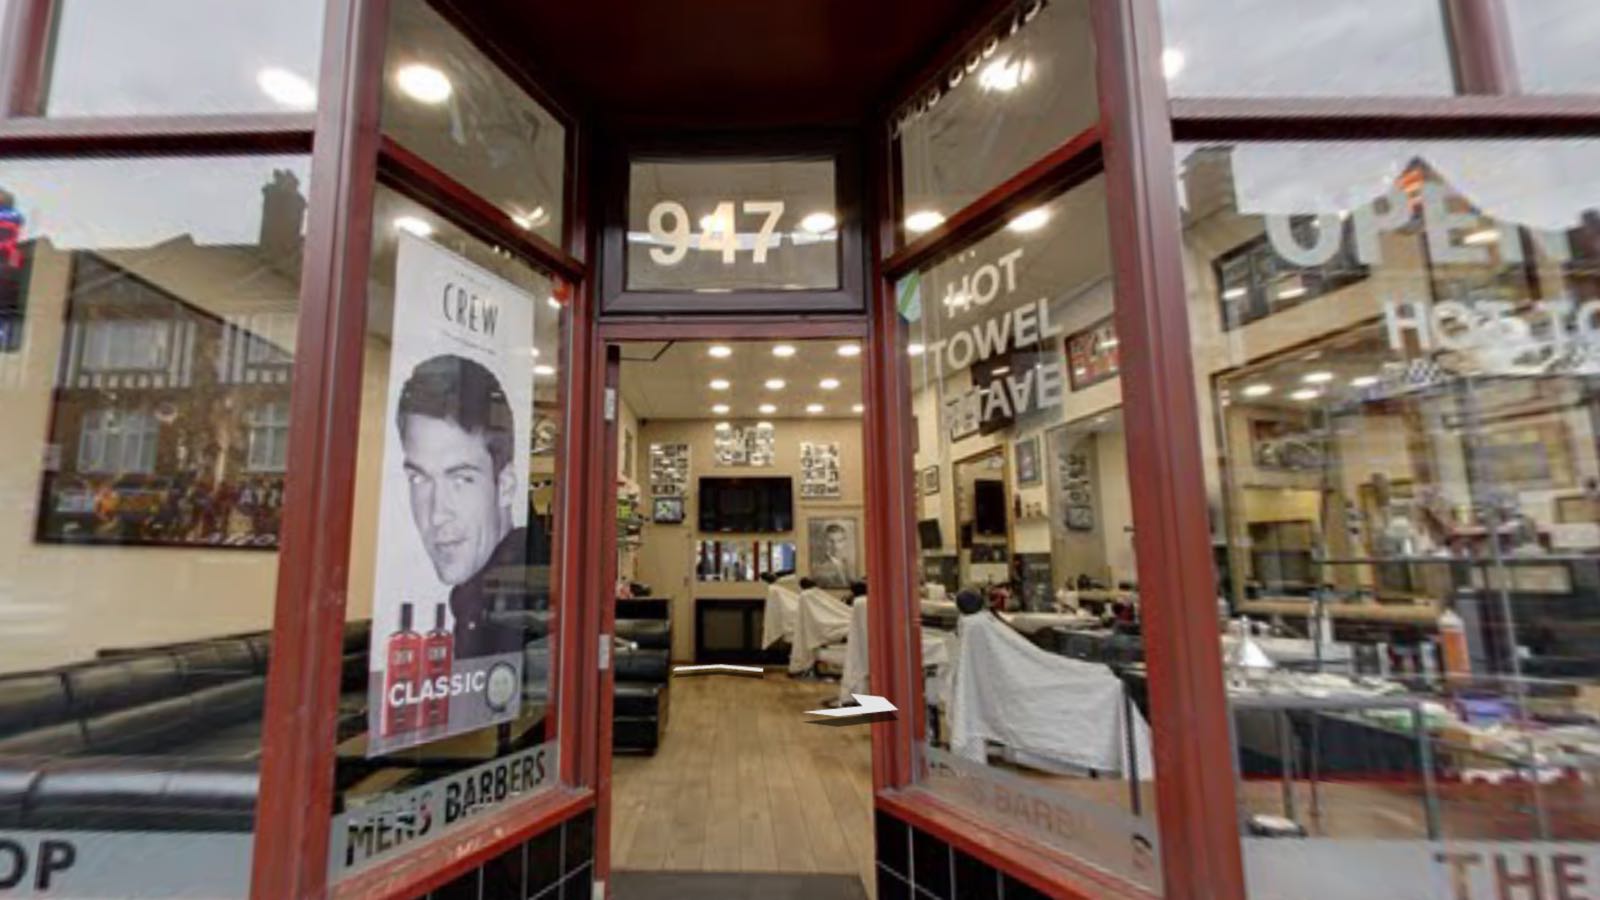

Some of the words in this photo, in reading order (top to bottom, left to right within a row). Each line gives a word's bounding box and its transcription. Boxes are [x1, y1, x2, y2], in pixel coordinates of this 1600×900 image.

[648, 200, 785, 265] 947
[443, 282, 498, 337] CREW
[943, 248, 1024, 318] HOT
[926, 297, 1063, 383] TOWEL
[390, 671, 487, 708] CLASSIC
[445, 750, 546, 825] BARBERS
[0, 839, 77, 891] OP
[1434, 852, 1587, 900] THE
